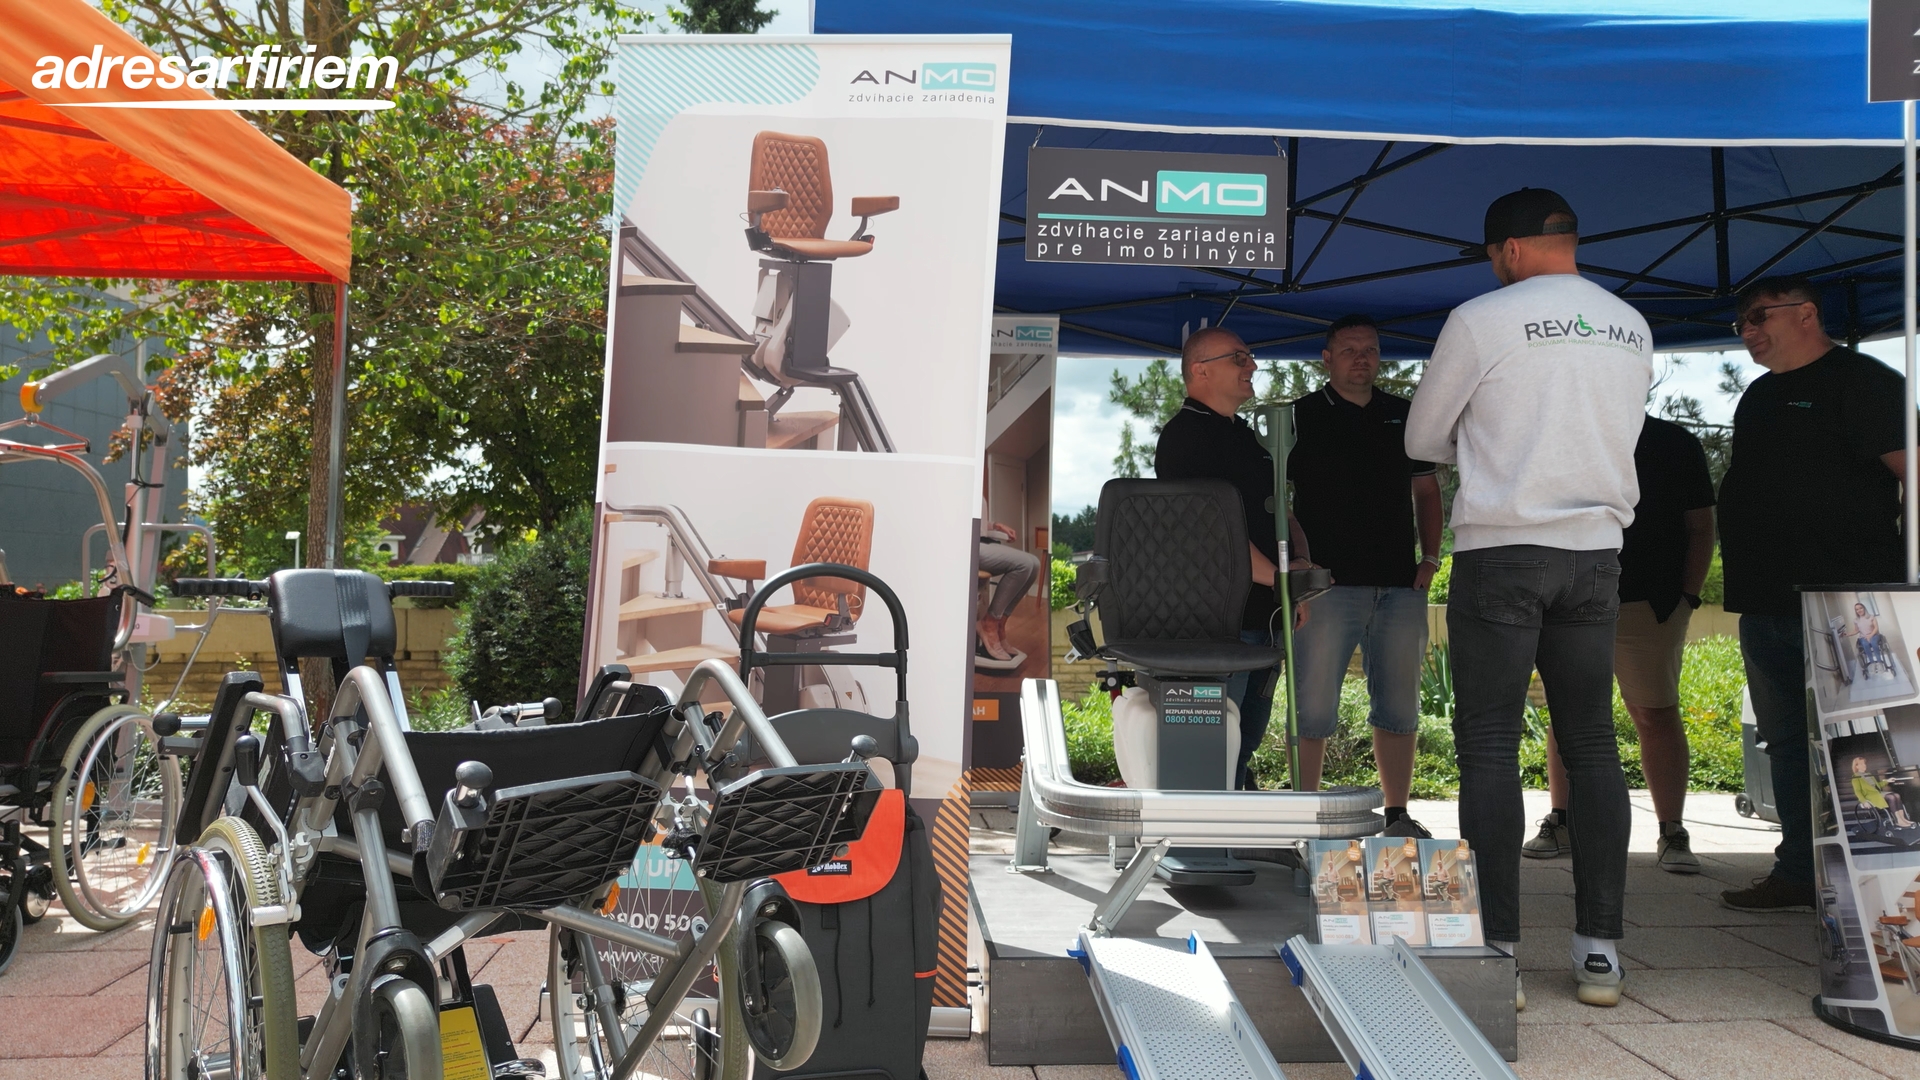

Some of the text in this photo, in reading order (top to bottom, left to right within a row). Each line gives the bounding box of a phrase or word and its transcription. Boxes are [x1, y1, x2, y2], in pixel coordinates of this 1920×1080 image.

[850, 69, 995, 86] ANMO
[922, 92, 995, 104] zariadenia
[1048, 178, 1264, 207] ANMO
[1038, 222, 1275, 244] zdvíhacie zariadenia
[1038, 242, 1274, 264] pre imobilných
[991, 329, 1052, 339] NMO
[1166, 688, 1221, 696] ANMO
[1165, 715, 1221, 724] 0800 500 082
